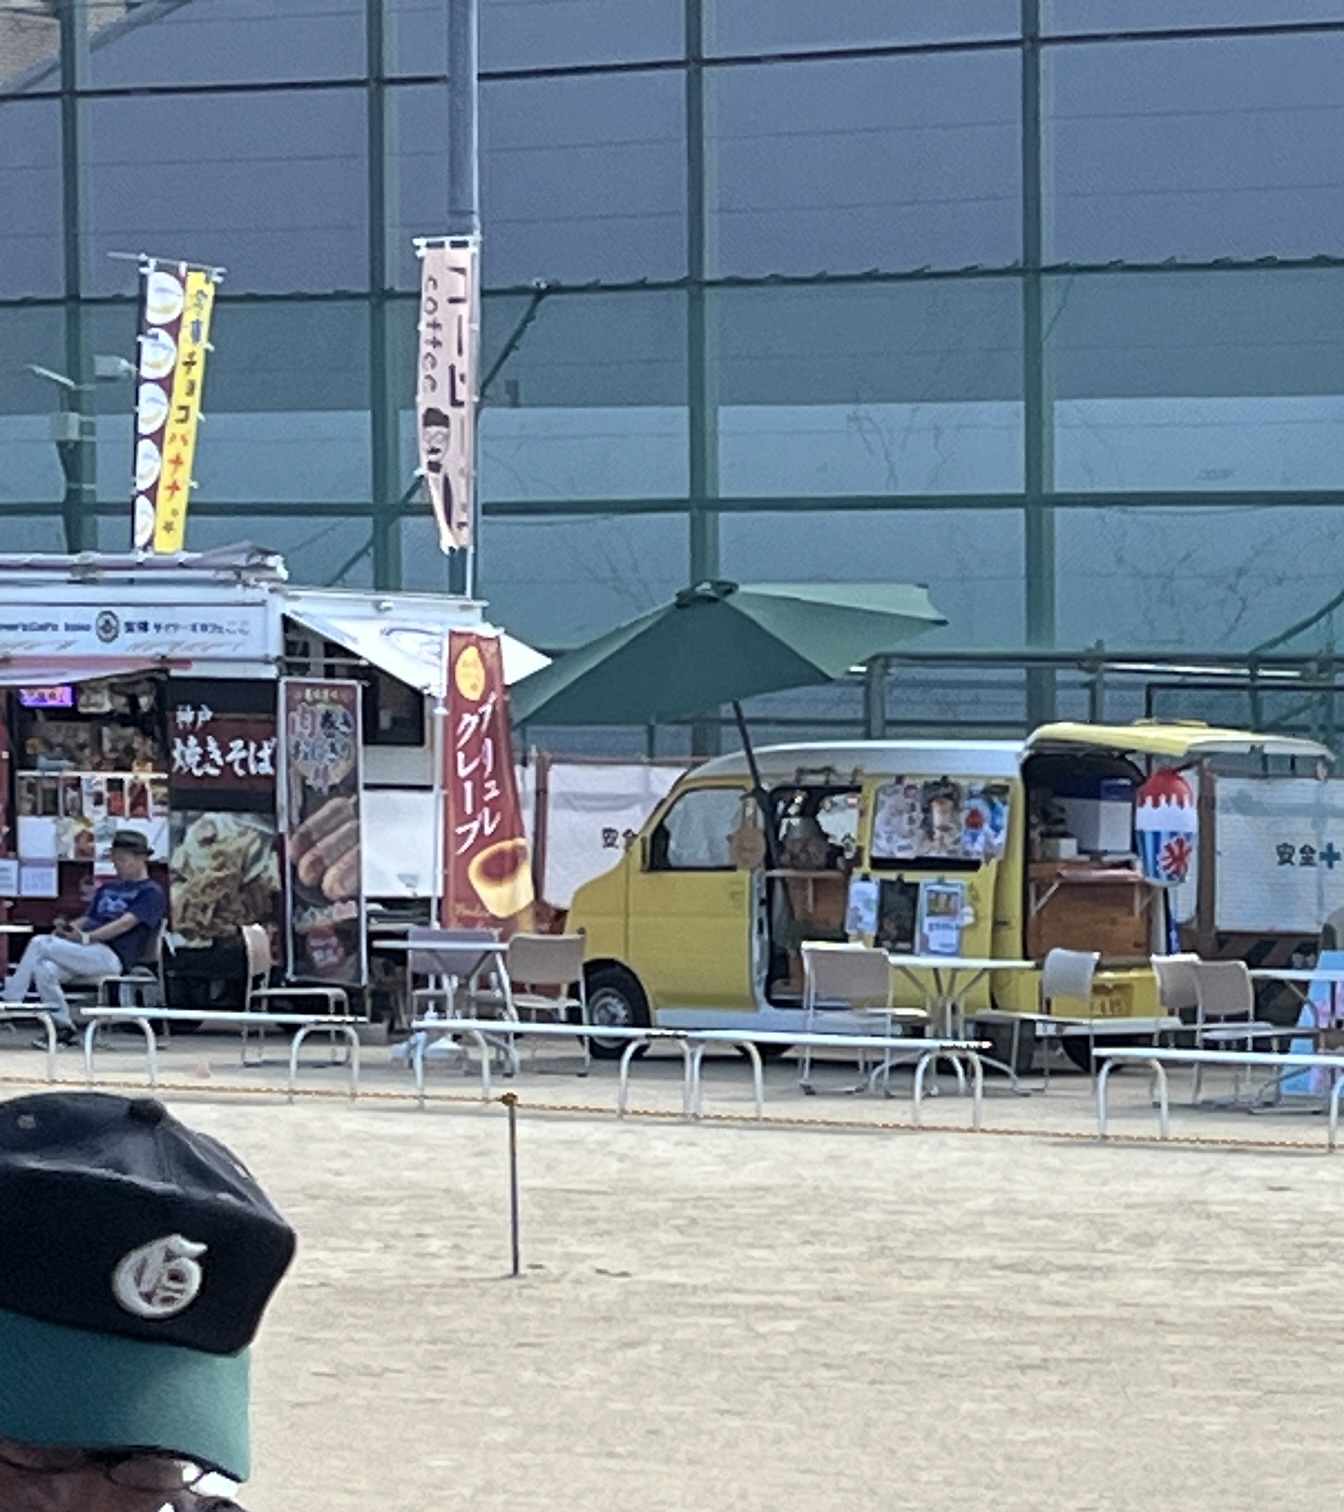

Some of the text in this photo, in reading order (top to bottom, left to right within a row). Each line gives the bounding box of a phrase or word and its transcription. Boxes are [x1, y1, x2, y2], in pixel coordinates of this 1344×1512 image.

[176, 703, 213, 732] 神戸
[171, 735, 277, 777] 焼きそば
[1276, 842, 1318, 867] 安全
